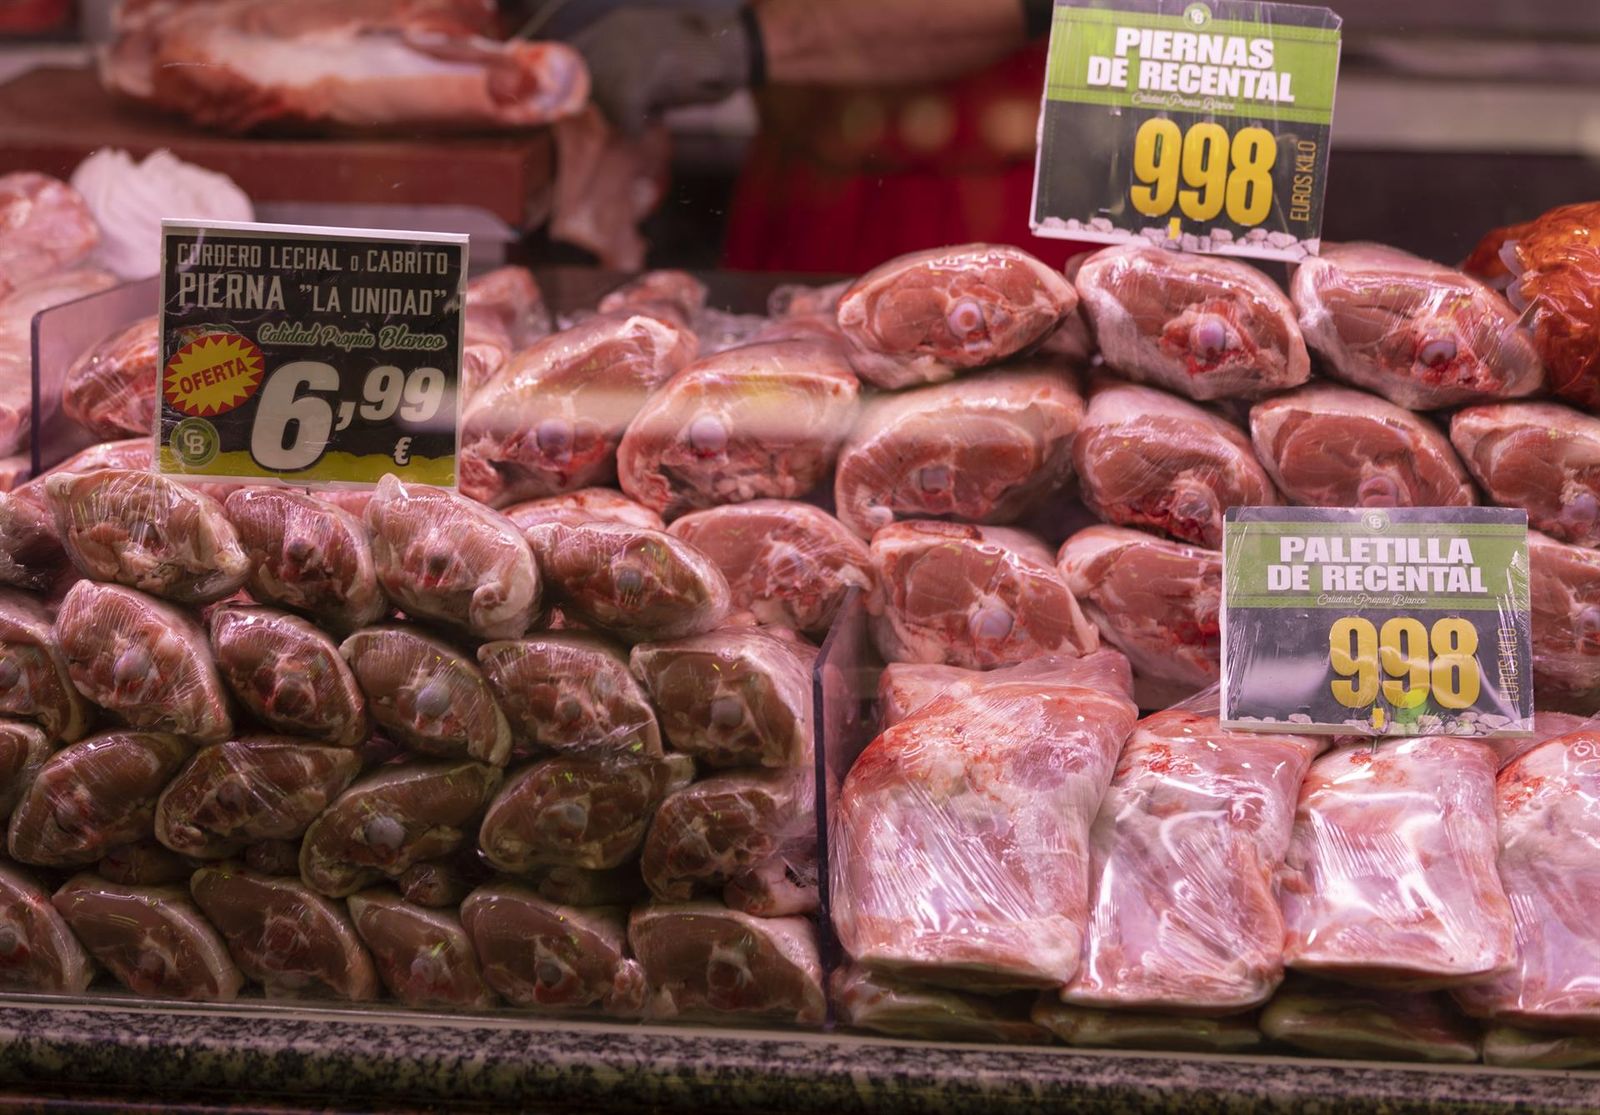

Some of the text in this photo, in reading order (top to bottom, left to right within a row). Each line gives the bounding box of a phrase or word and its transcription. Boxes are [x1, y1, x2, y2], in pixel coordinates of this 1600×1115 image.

[1115, 27, 1274, 69] PIERNAS
[1087, 56, 1295, 102] DE RECENTAL
[1290, 140, 1316, 221] EUROS KILO
[176, 243, 261, 269] CORDERO
[270, 247, 342, 271] LECHAL
[367, 249, 448, 275] CABRITO
[178, 271, 285, 311] PIERNA
[258, 321, 448, 352] Calidad Propia Blanco
[179, 356, 249, 394] OFERTA
[251, 361, 446, 471] 6,99
[394, 436, 412, 466] €
[1280, 536, 1474, 564] PALETILLA
[1267, 565, 1488, 593] DE RECENTAL
[1317, 593, 1352, 606] Calidad
[1392, 593, 1427, 606] Blanco
